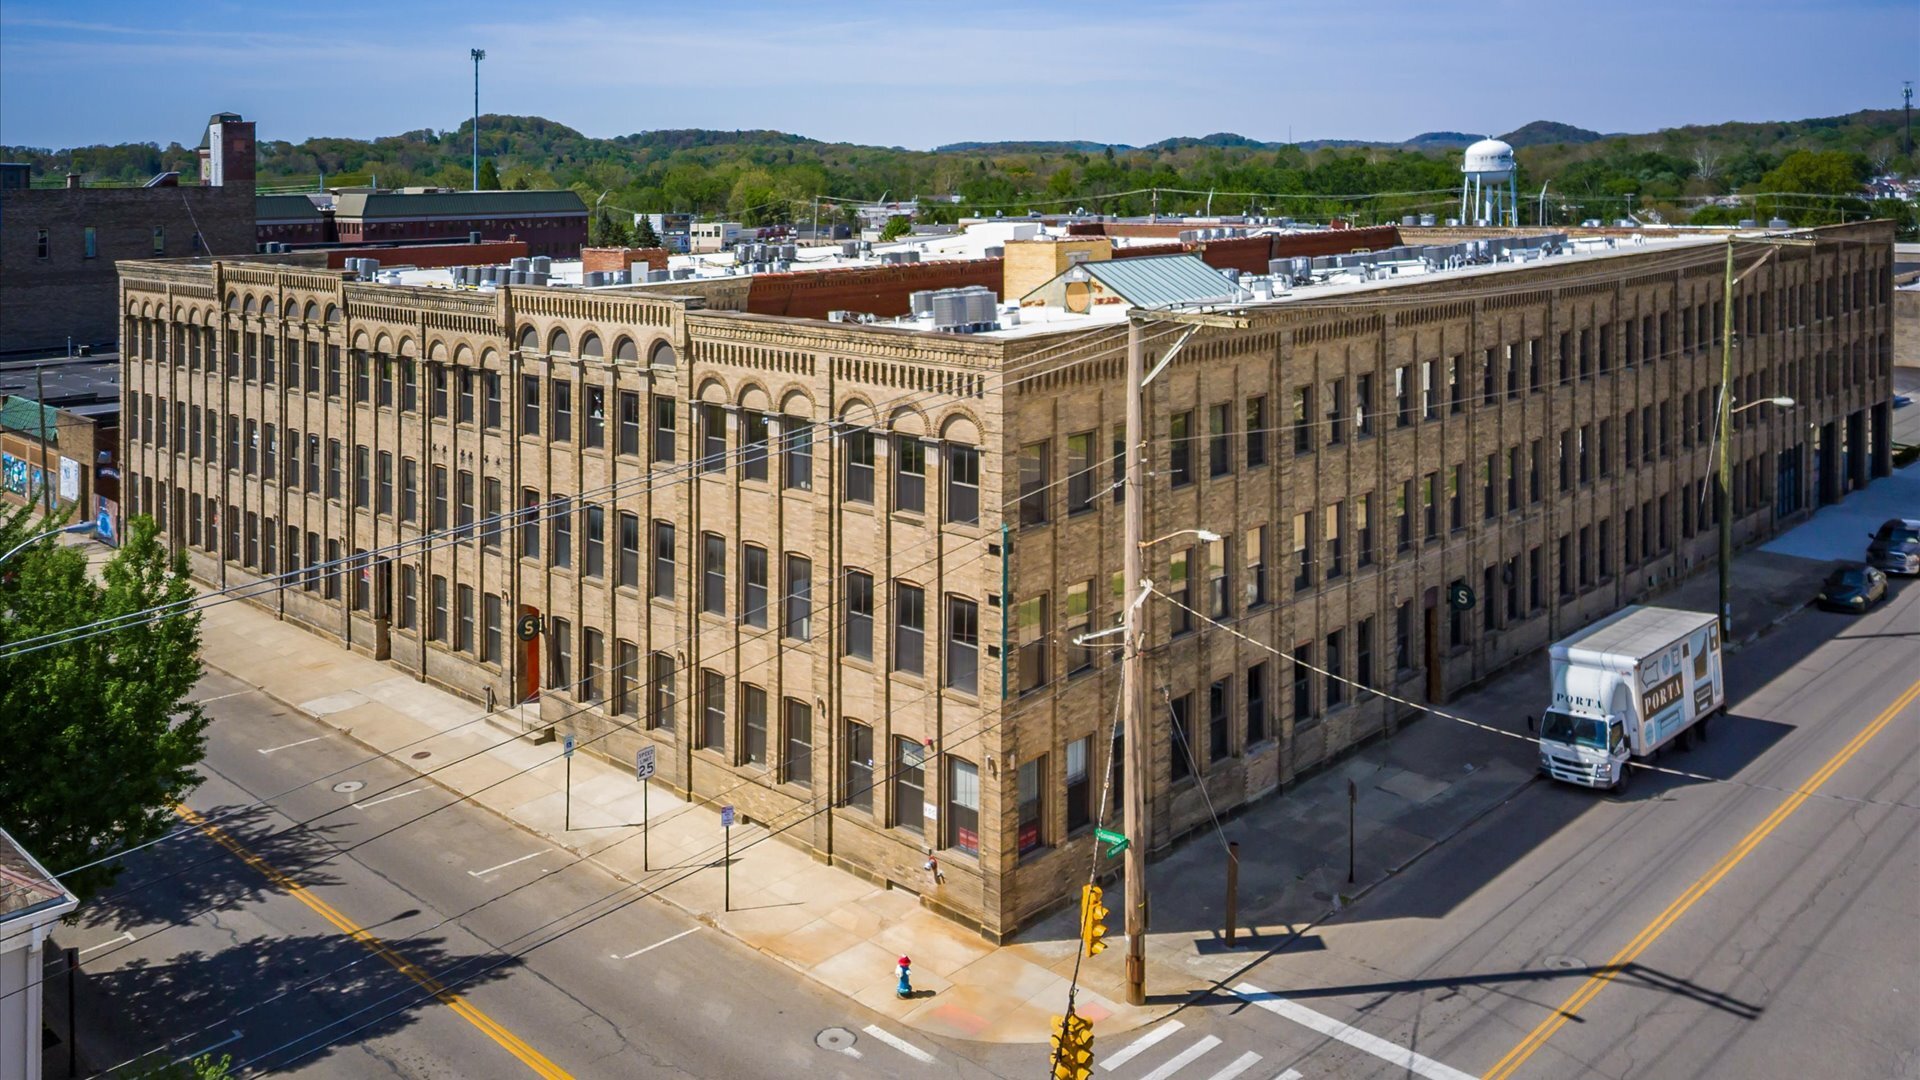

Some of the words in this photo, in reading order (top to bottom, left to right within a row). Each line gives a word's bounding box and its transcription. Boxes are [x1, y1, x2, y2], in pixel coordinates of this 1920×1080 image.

[1458, 590, 1468, 604] S
[524, 620, 534, 635] S
[1556, 693, 1602, 709] PORTA
[1644, 679, 1682, 715] PORTA
[638, 749, 653, 760] SPEED
[639, 755, 652, 765] LIMIT
[638, 762, 654, 777] 25
